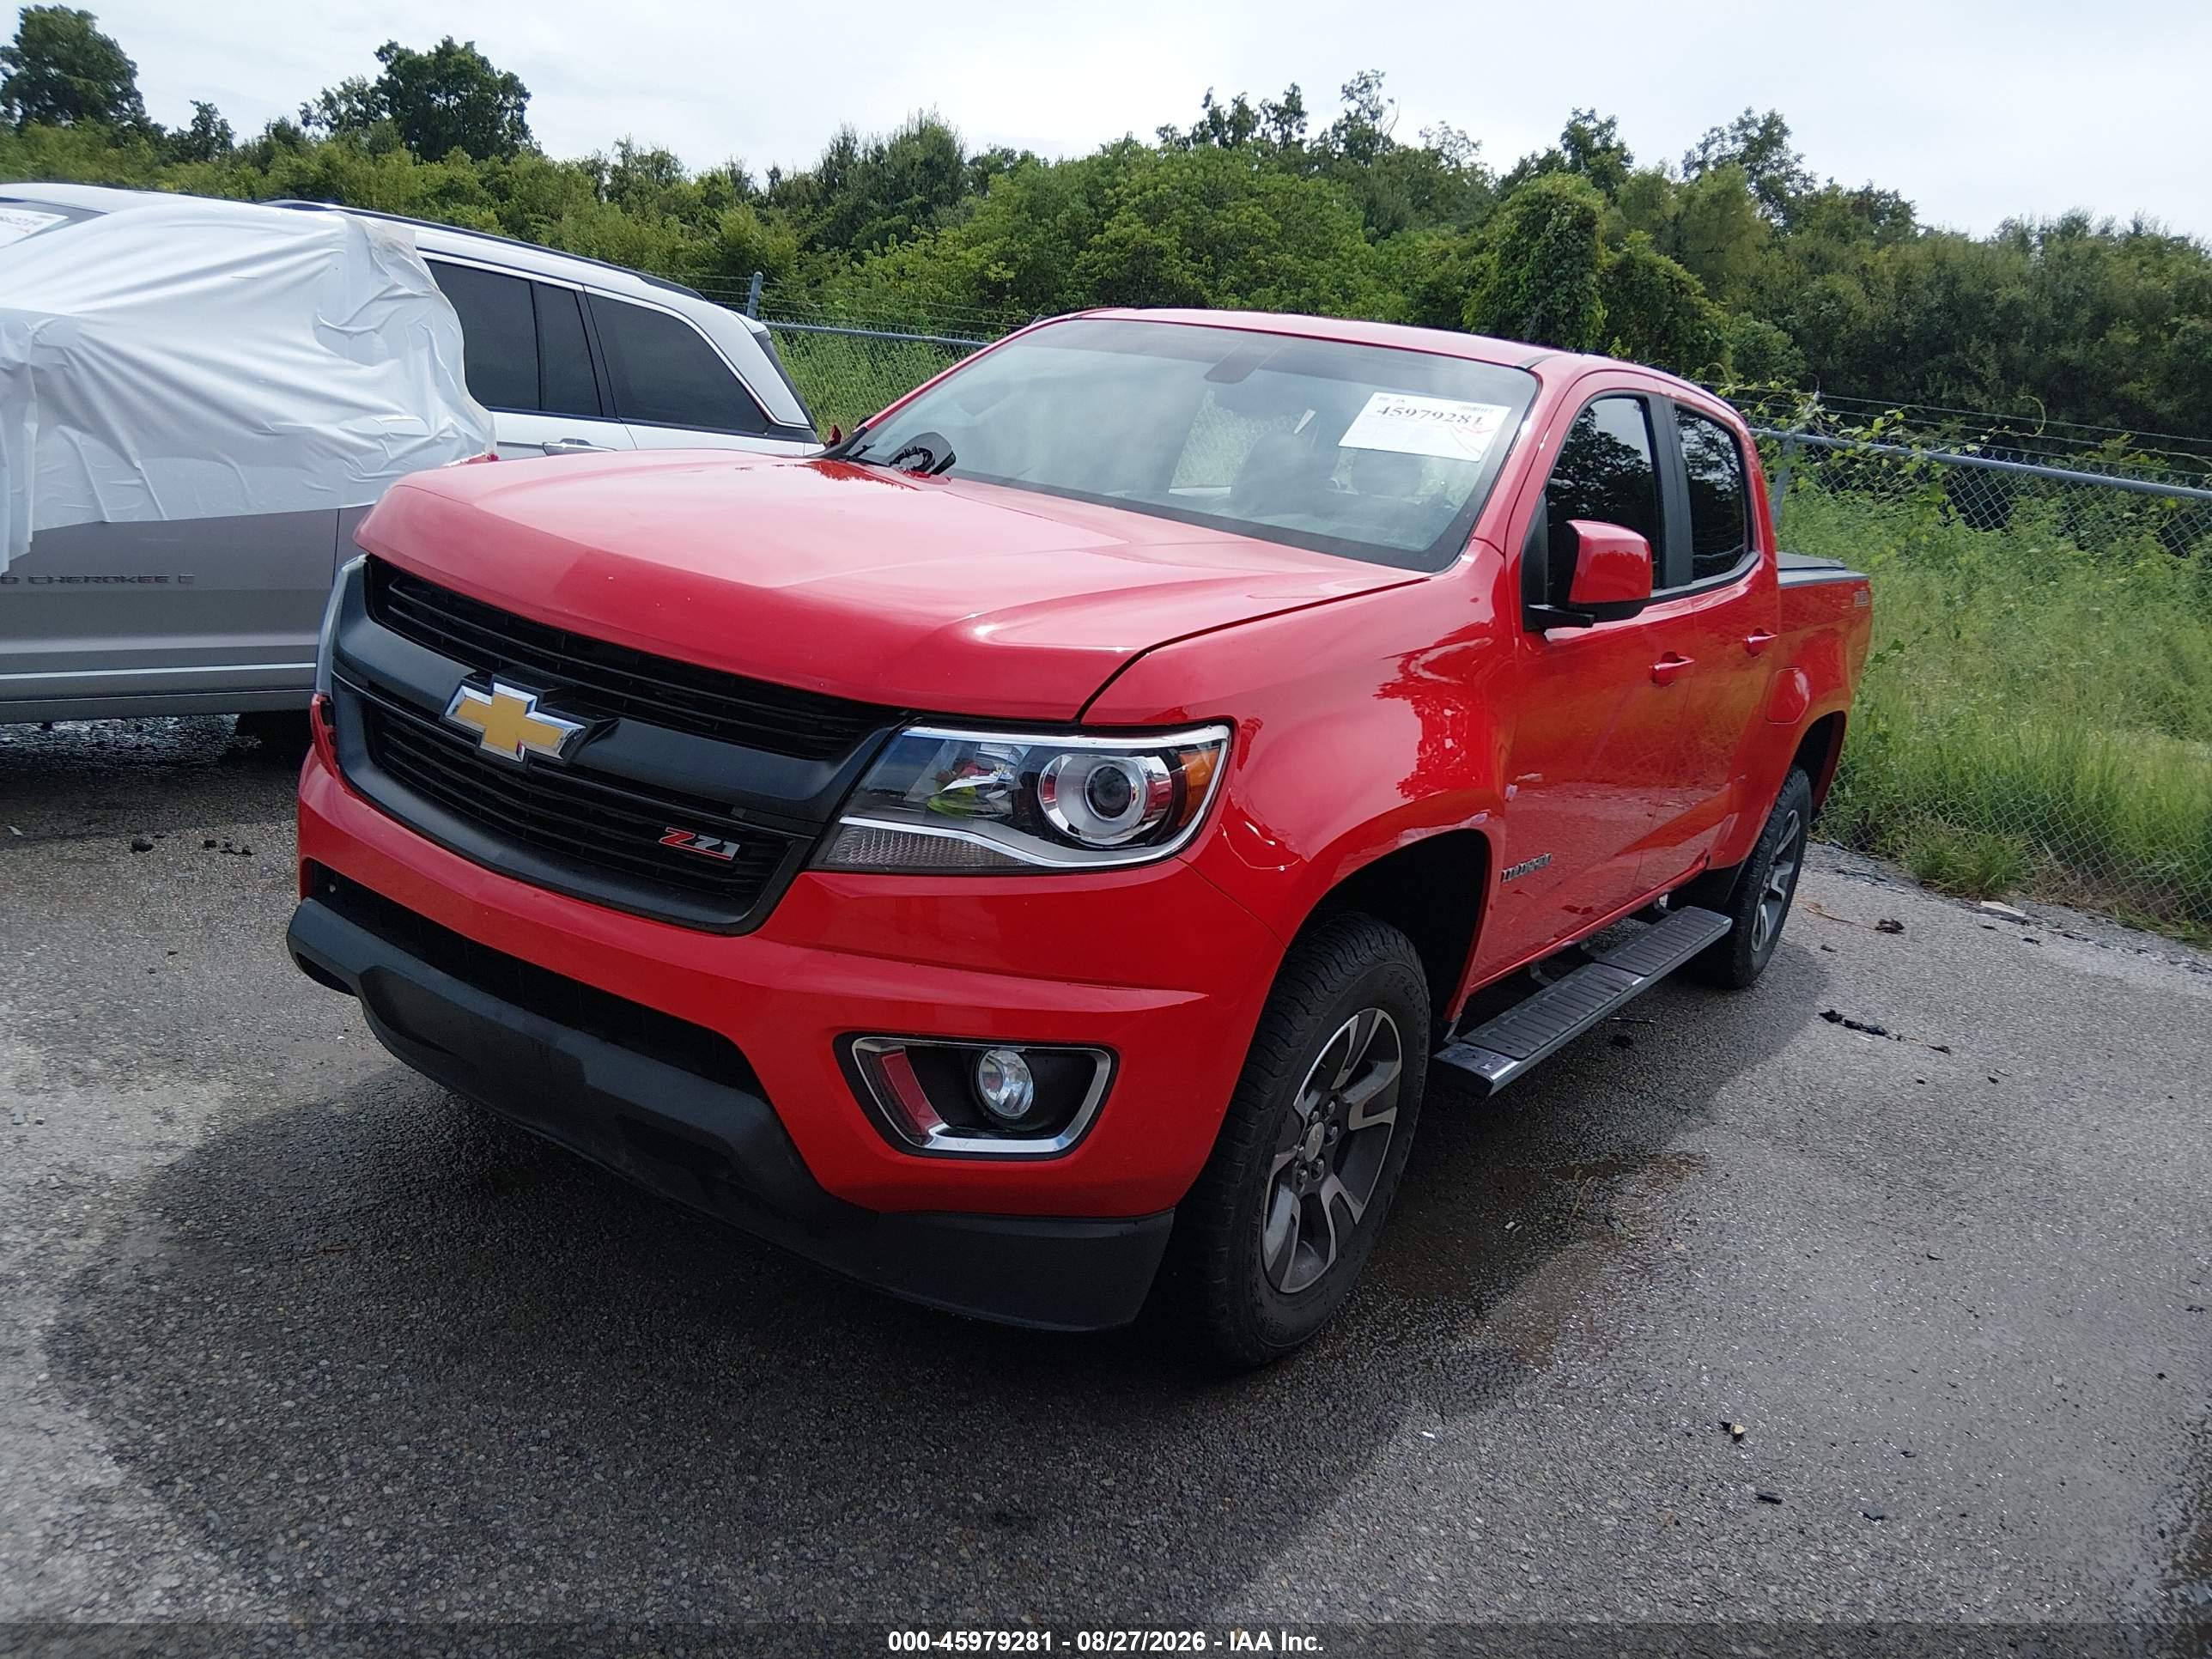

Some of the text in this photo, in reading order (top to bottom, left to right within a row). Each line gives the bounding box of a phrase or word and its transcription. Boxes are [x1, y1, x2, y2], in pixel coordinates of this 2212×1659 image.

[1376, 404, 1484, 428] 45979281
[27, 574, 172, 585] CHEROKEE
[658, 826, 741, 861] Z71
